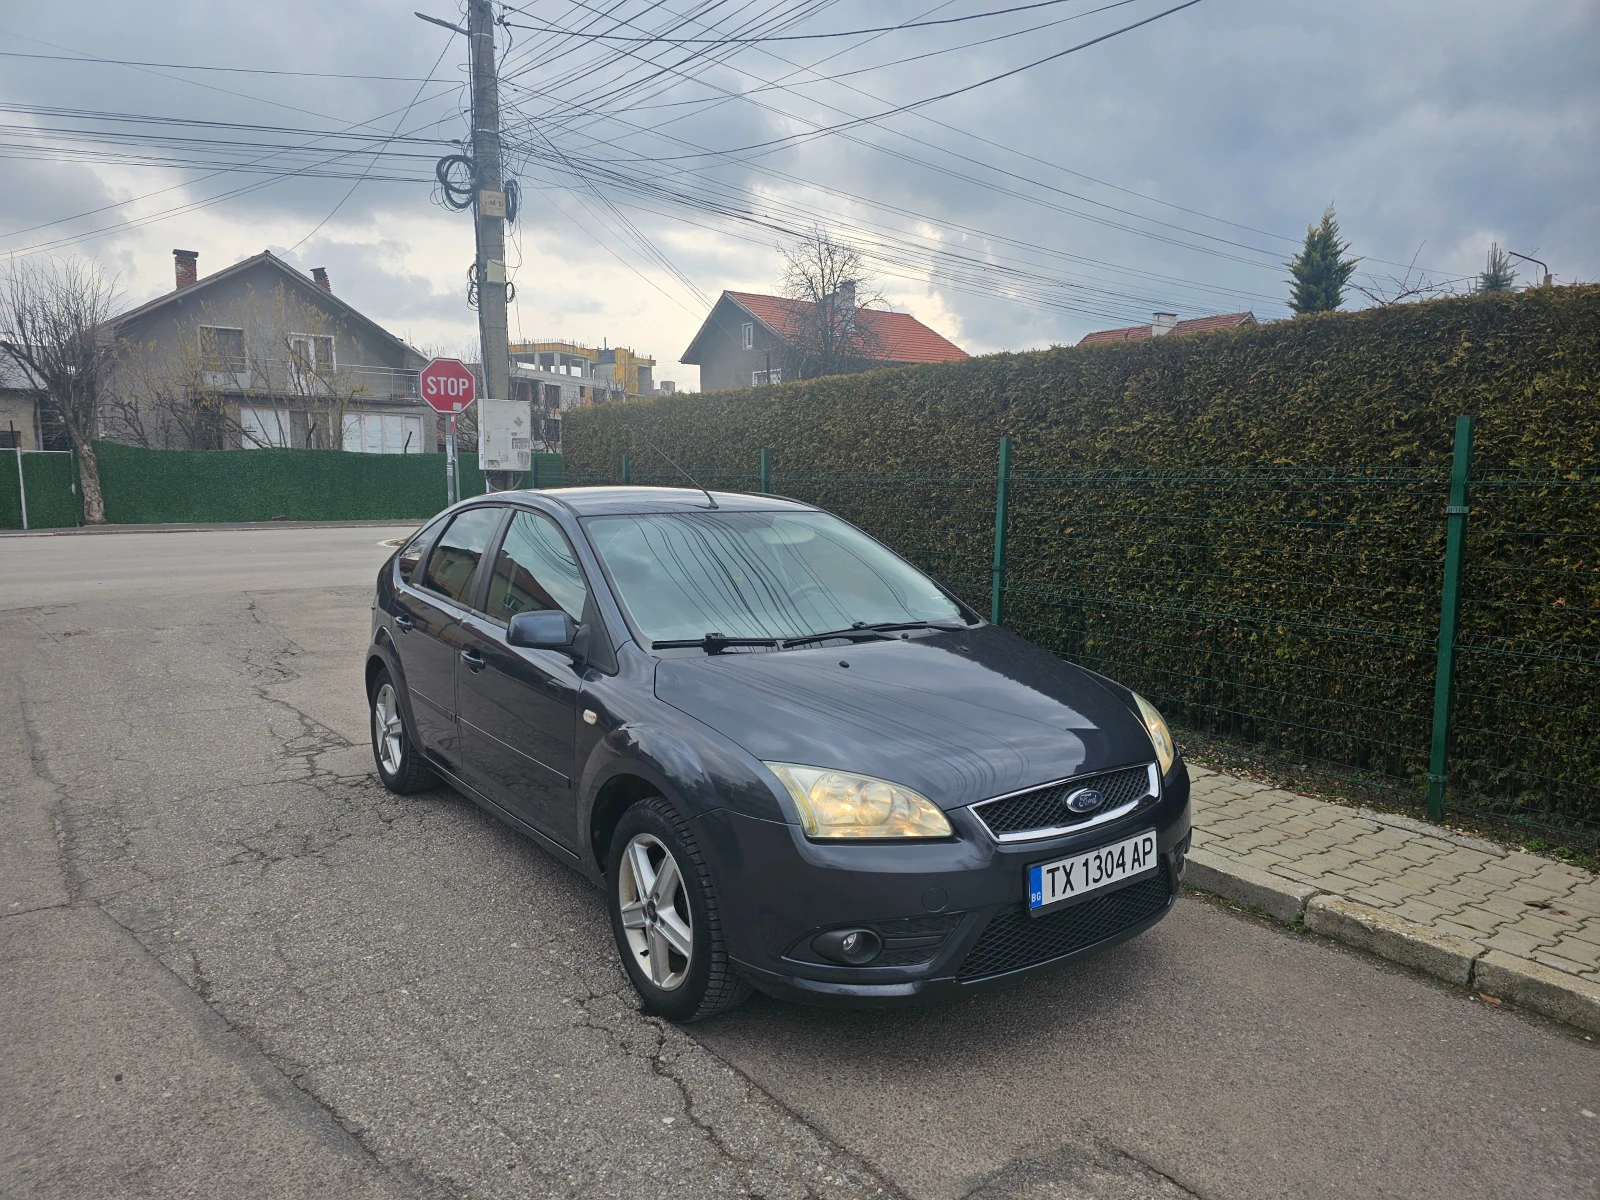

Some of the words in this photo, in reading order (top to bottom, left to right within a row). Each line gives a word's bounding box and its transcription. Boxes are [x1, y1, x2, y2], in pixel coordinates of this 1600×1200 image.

[427, 376, 469, 396] STOP
[1079, 793, 1097, 807] Ford
[1046, 862, 1075, 897] TX
[1082, 846, 1126, 887] 1304
[1131, 837, 1153, 870] AP
[1031, 892, 1042, 903] BG
